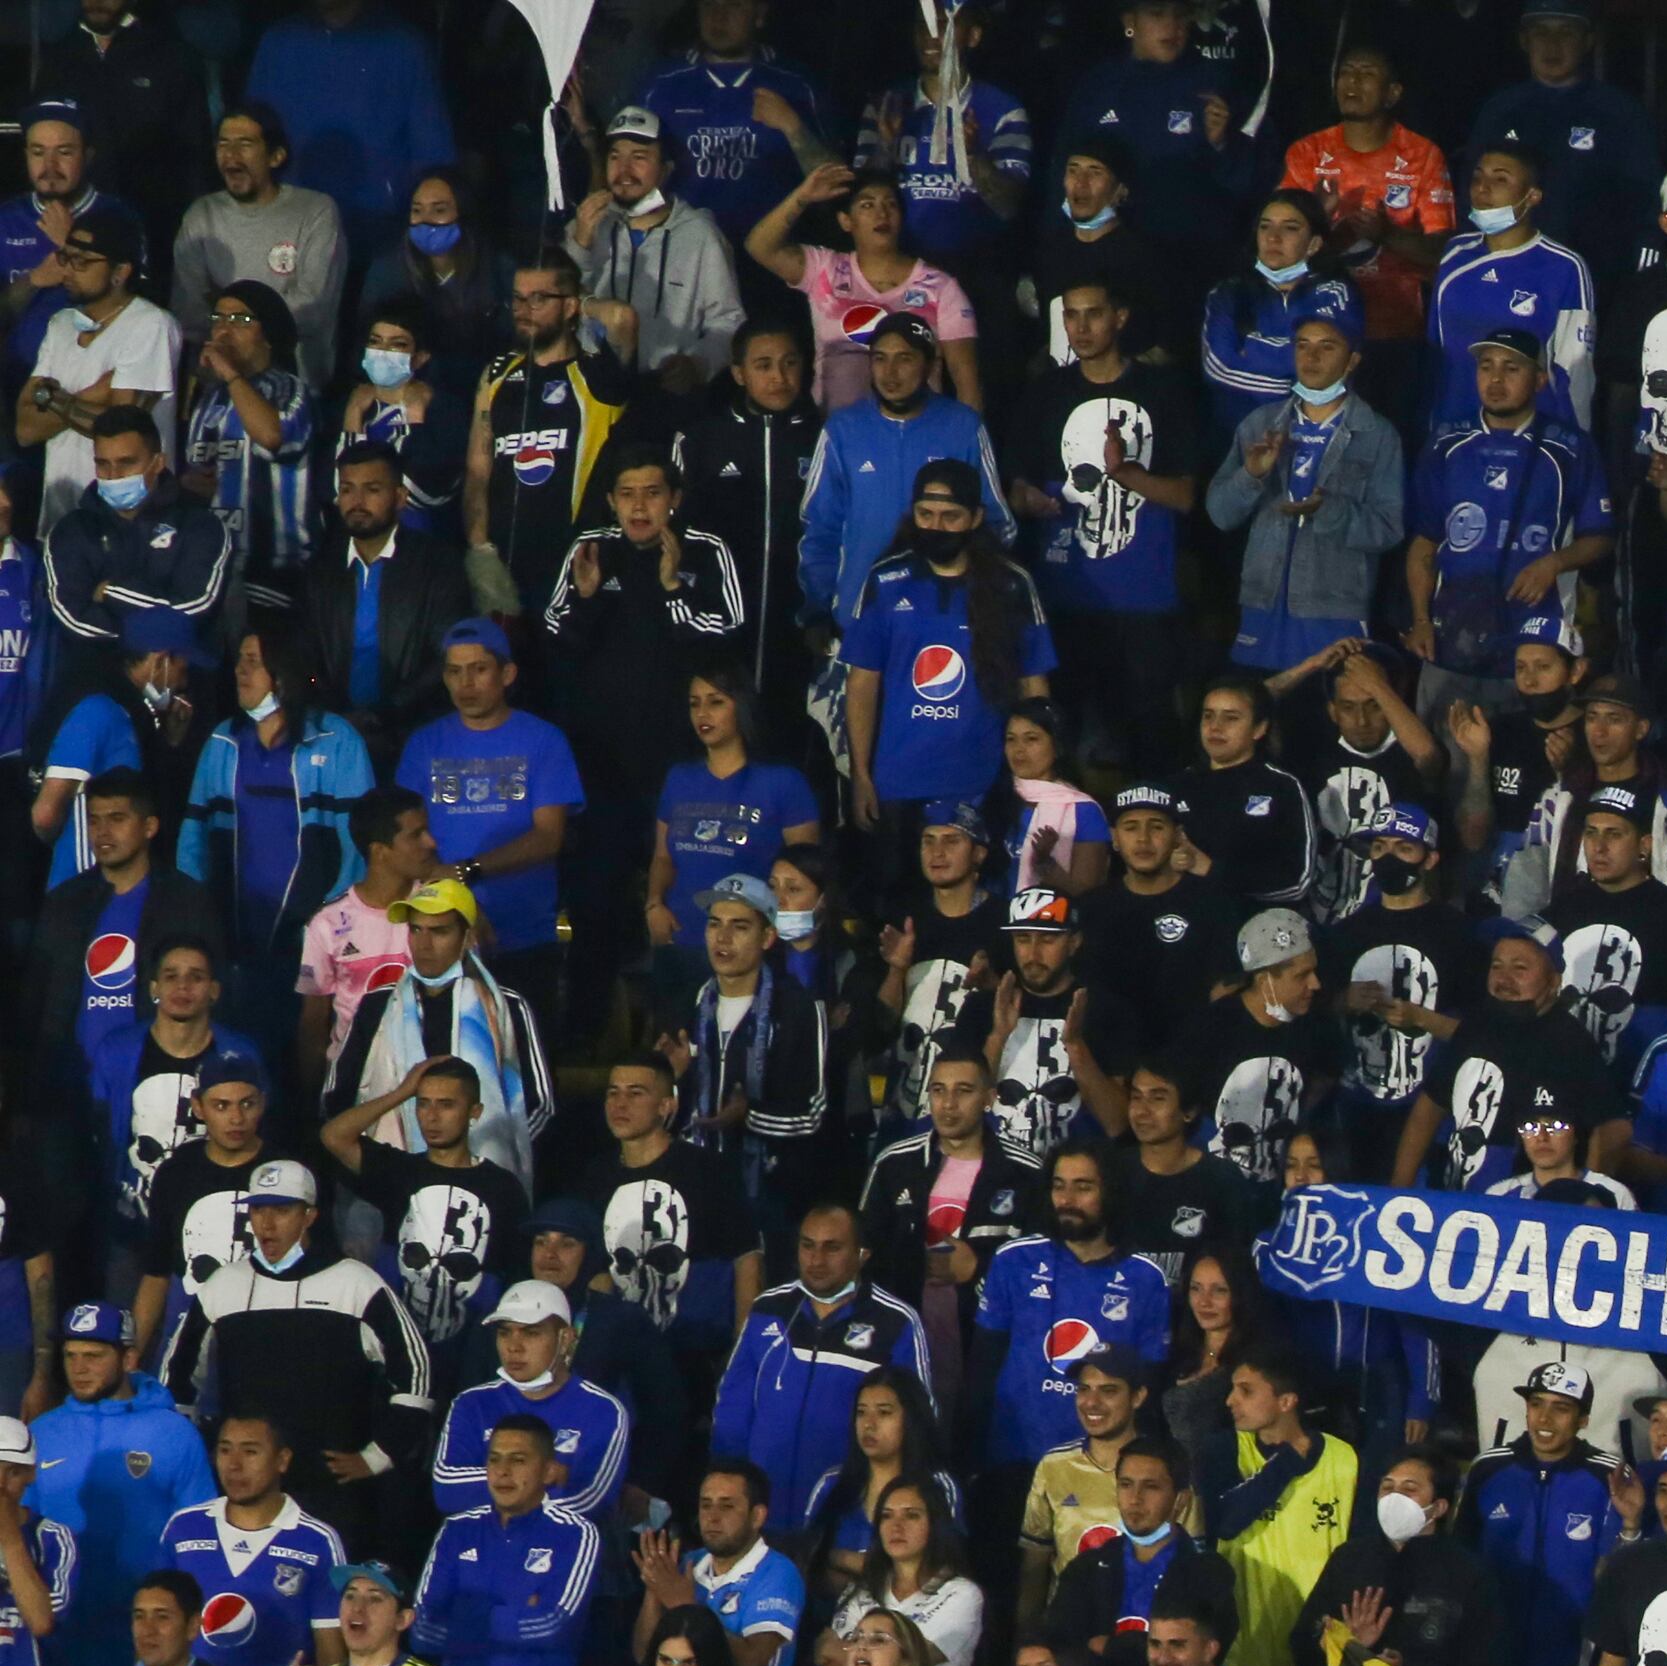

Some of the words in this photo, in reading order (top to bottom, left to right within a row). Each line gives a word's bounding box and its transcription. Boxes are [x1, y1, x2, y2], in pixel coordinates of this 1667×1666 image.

[686, 133, 760, 161] CRISTAL
[695, 156, 744, 181] ORO
[493, 428, 569, 458] PEPSI
[911, 704, 961, 721] pepsi
[88, 996, 135, 1011] pepsi
